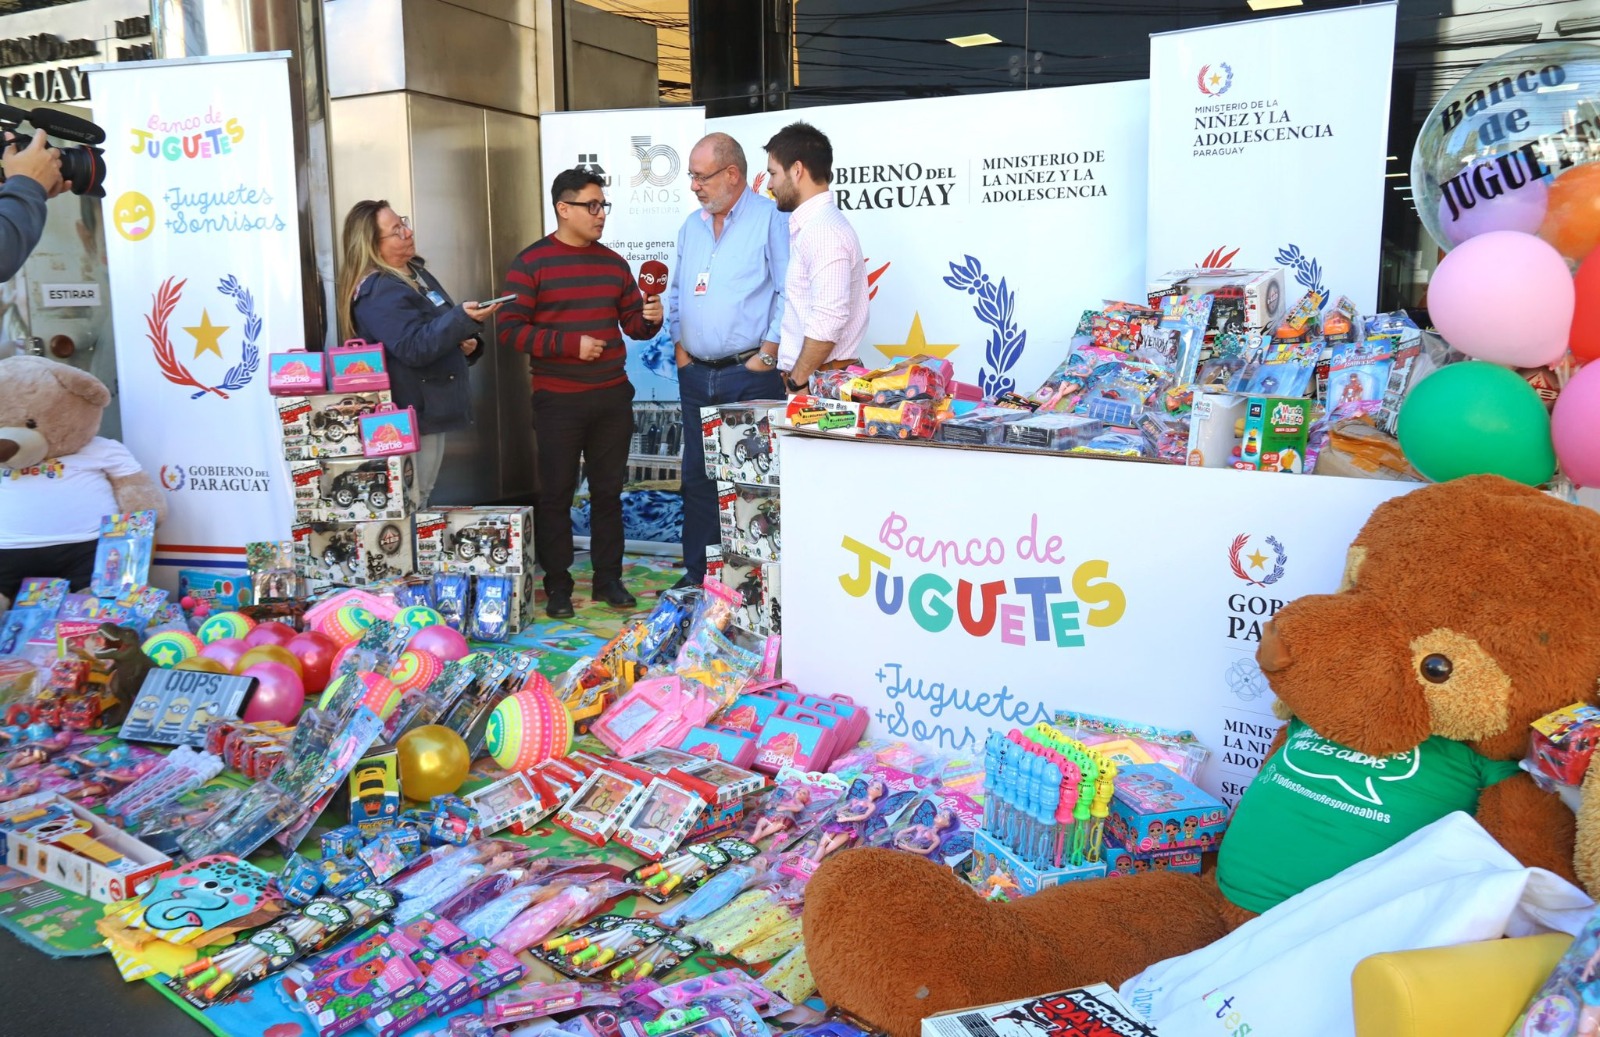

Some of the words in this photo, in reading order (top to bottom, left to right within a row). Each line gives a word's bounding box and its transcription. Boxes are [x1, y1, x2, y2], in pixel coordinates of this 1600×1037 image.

[0, 66, 91, 104] GUAY
[1195, 102, 1248, 114] MINISTERIO
[1250, 100, 1264, 109] DE
[1267, 99, 1279, 107] LA
[1441, 65, 1566, 136] Banco
[147, 114, 200, 133] Banco
[205, 105, 222, 123] de
[1194, 112, 1249, 130] NIÑEZ
[1254, 112, 1265, 125] Y
[1269, 109, 1291, 124] LA
[1478, 108, 1530, 146] de
[130, 117, 245, 161] JUGUETES
[1193, 124, 1334, 147] ADOLESCENCIA
[630, 135, 681, 187] 50
[982, 152, 1079, 170] MINISTERIO
[1083, 150, 1105, 163] DE
[1193, 147, 1245, 157] PARAGUAY
[828, 163, 923, 185] BIERNO
[926, 168, 956, 180] DEL
[982, 174, 1002, 187] LA
[1006, 169, 1057, 185] NIÑEZ
[1059, 170, 1070, 182] Y
[1074, 168, 1095, 181] LA
[630, 186, 681, 203] AÑOS
[836, 183, 956, 210] RAGUAY
[981, 184, 1108, 203] ADOLESCENCIA
[627, 241, 642, 250] que
[645, 240, 675, 250] genera
[626, 252, 669, 261] desarrollo
[50, 289, 95, 299] ESTIRAR
[282, 375, 310, 384] Barbie
[816, 400, 834, 409] Dream
[376, 440, 403, 452] Barbie
[189, 466, 254, 477] GOBIERNO
[190, 479, 271, 492] PARAGUAY
[879, 511, 1005, 567] Banco
[1016, 513, 1066, 564] de
[838, 535, 1126, 648] JUGUETES
[1228, 593, 1285, 617] GOB
[1227, 616, 1263, 643] PA
[165, 671, 222, 695] OOPS
[1224, 718, 1279, 741] MINIS
[1223, 735, 1242, 750] LA
[1246, 739, 1272, 756] NI
[1311, 742, 1337, 756] LES
[1335, 749, 1388, 770] CUIDAS
[761, 750, 794, 768] Barbie
[1222, 753, 1264, 770] ADO
[1272, 773, 1391, 824] #TodosSomosResponsables
[1203, 809, 1226, 822] LOL
[355, 889, 392, 908] GLOW
[306, 902, 347, 924] GLOW
[250, 931, 293, 954] GLOW
[663, 937, 693, 951] LOW
[1066, 992, 1158, 1037] ACROBA
